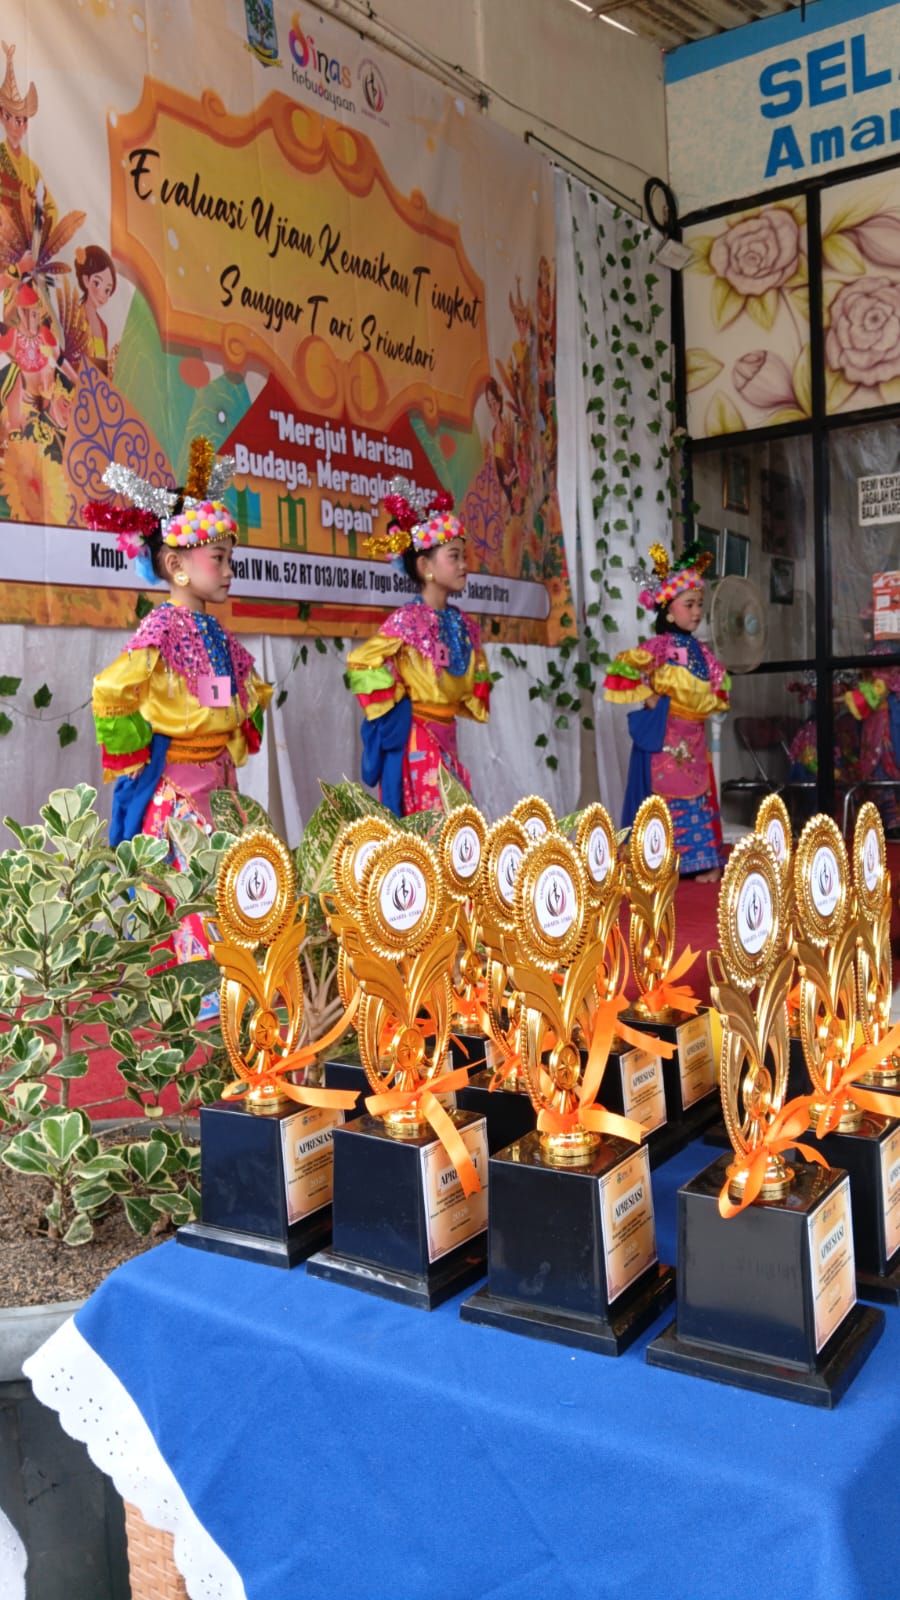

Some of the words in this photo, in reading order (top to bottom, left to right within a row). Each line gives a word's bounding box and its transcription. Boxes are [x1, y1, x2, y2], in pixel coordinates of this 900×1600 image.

[759, 33, 900, 119] SEL
[129, 149, 247, 230] Evaluasi
[251, 197, 315, 258] Ujian
[319, 224, 410, 298] Kenaikan
[412, 266, 481, 329] Tingkat
[219, 265, 304, 333] Sanggar
[307, 295, 355, 342] Tari
[361, 314, 436, 371] Sriwedari
[235, 444, 312, 490] Budaya,
[352, 429, 413, 470] Warisan
[880, 475, 900, 489] KENY
[90, 543, 127, 572] Kmp.
[251, 558, 262, 580] IV
[265, 560, 281, 582] No.
[284, 562, 297, 584] 52
[300, 563, 312, 585] RT
[314, 564, 349, 588] 013/03
[351, 568, 367, 590] Kel.
[369, 571, 391, 593] Tugu
[468, 581, 492, 600] Jakarta
[493, 584, 509, 602] Utara
[211, 685, 219, 699] 1
[298, 1129, 334, 1155] APRESIAS
